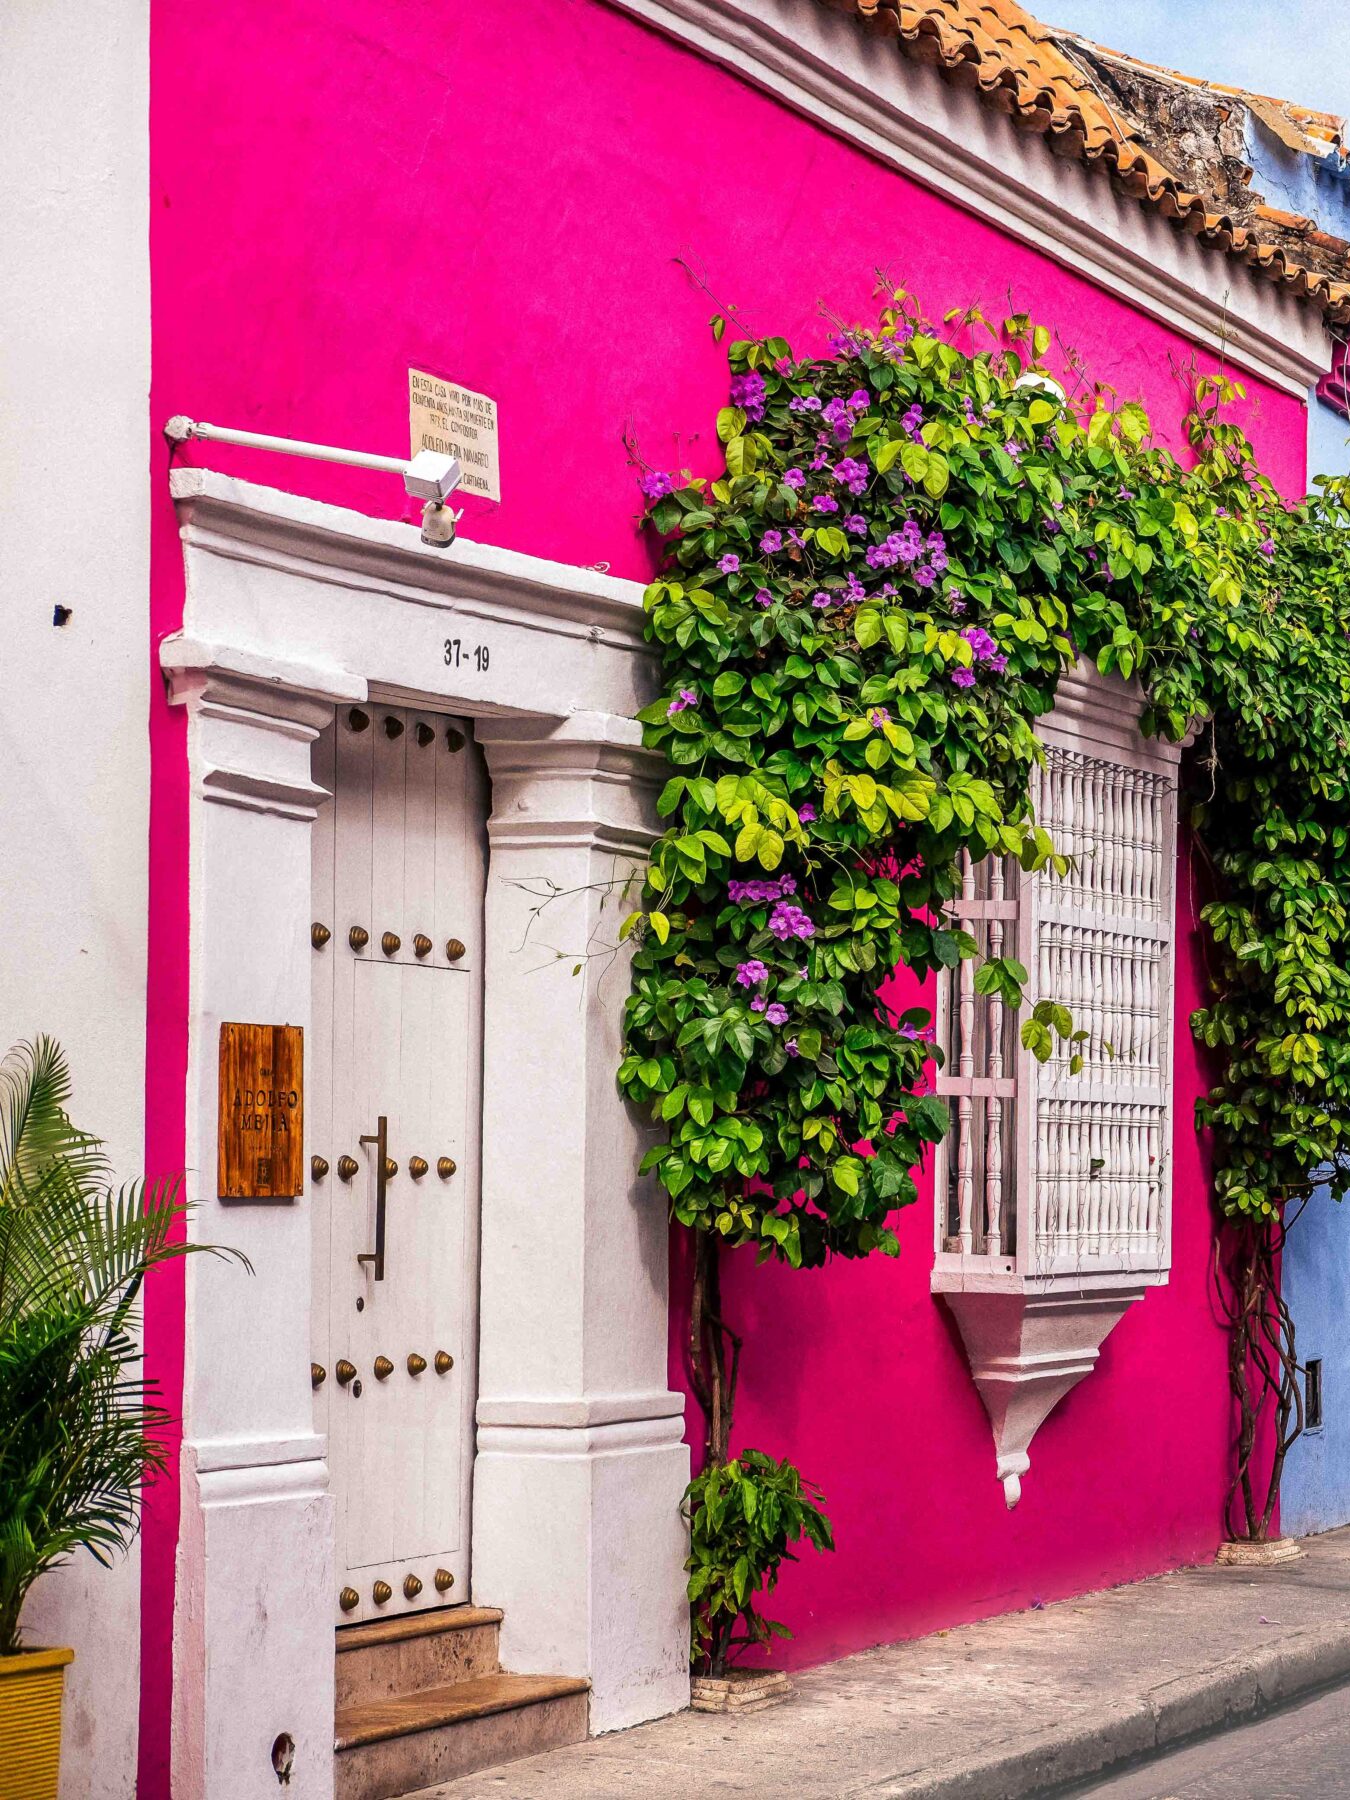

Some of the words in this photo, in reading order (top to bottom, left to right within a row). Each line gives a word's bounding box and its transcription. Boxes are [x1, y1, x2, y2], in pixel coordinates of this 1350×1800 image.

[412, 375, 420, 389] EN
[421, 378, 432, 393] ESTA
[435, 383, 447, 398] CASA
[461, 393, 471, 408] POR
[485, 402, 492, 415] DE
[412, 391, 435, 410] CUARENTA
[463, 410, 470, 423] SU
[470, 412, 487, 429] MUERTE
[488, 418, 495, 431] EN
[442, 417, 449, 431] EL
[463, 447, 489, 469] NAVARRO
[233, 1087, 298, 1109] ADOLFO
